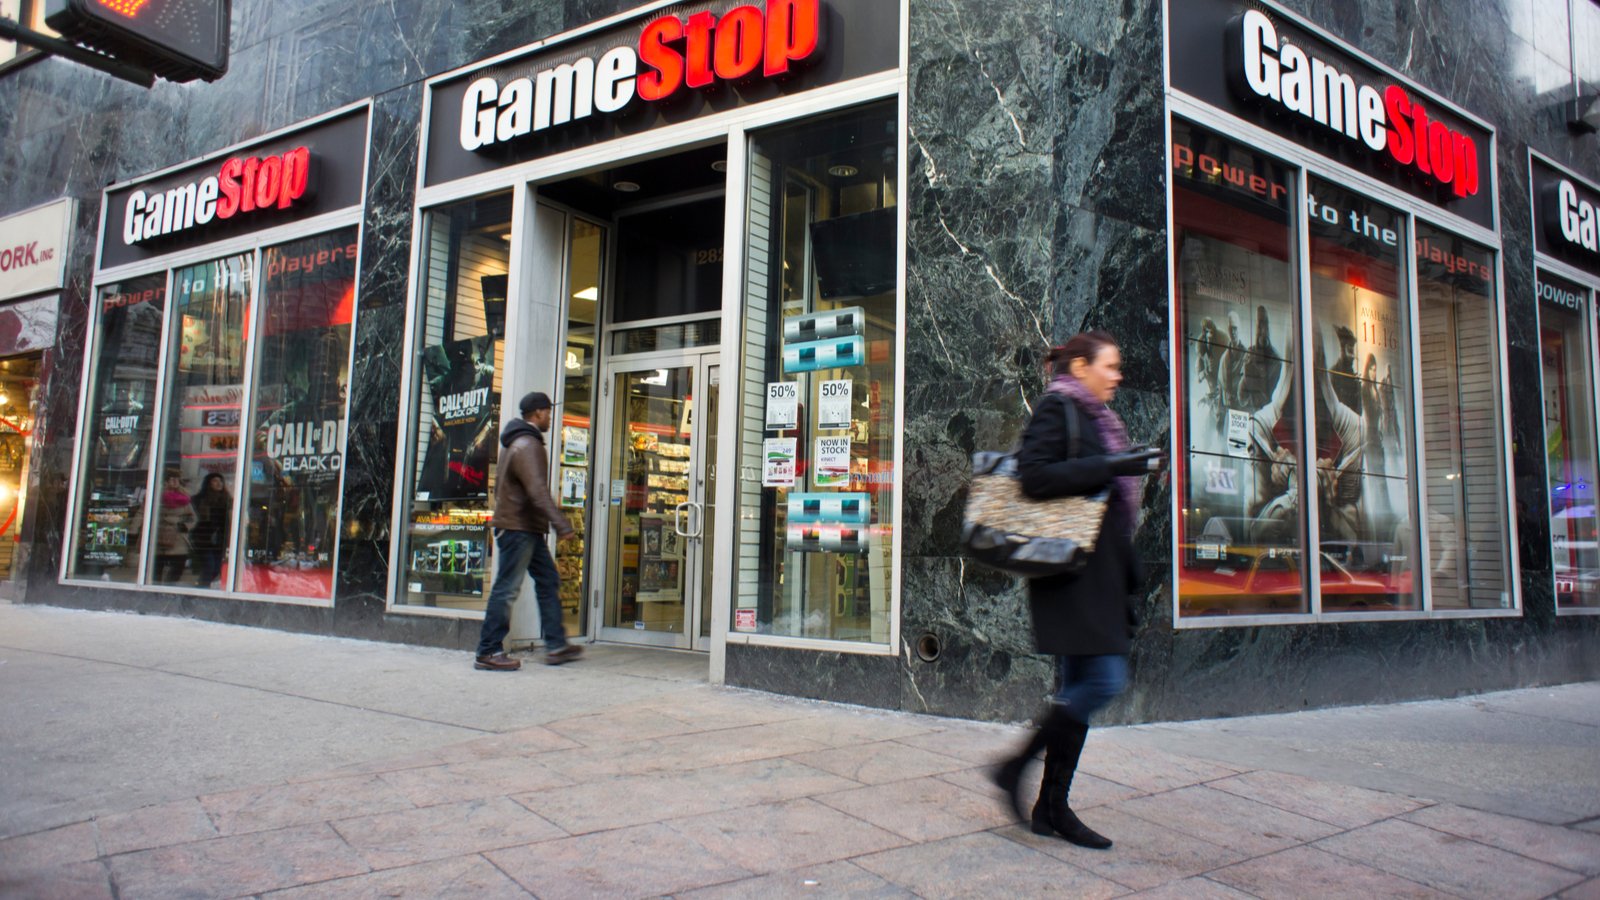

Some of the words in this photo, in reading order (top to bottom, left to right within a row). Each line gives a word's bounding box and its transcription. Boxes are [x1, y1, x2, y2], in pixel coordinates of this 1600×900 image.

[460, 0, 819, 151] GameStop
[1242, 9, 1478, 199] GameStop
[123, 146, 310, 246] GameStop
[1173, 143, 1287, 200] power
[1307, 194, 1338, 225] to
[1350, 210, 1397, 246] the
[0, 241, 38, 272] ORK,
[104, 287, 165, 313] power
[183, 278, 204, 294] to
[214, 268, 252, 288] the
[268, 244, 357, 280] players
[1363, 321, 1397, 351] 11.16
[440, 393, 461, 414] CALL
[463, 387, 489, 409] DUTY
[771, 385, 796, 398] 50%
[822, 382, 849, 396] 50%
[267, 422, 315, 459] CALL
[283, 456, 327, 471] BLACK
